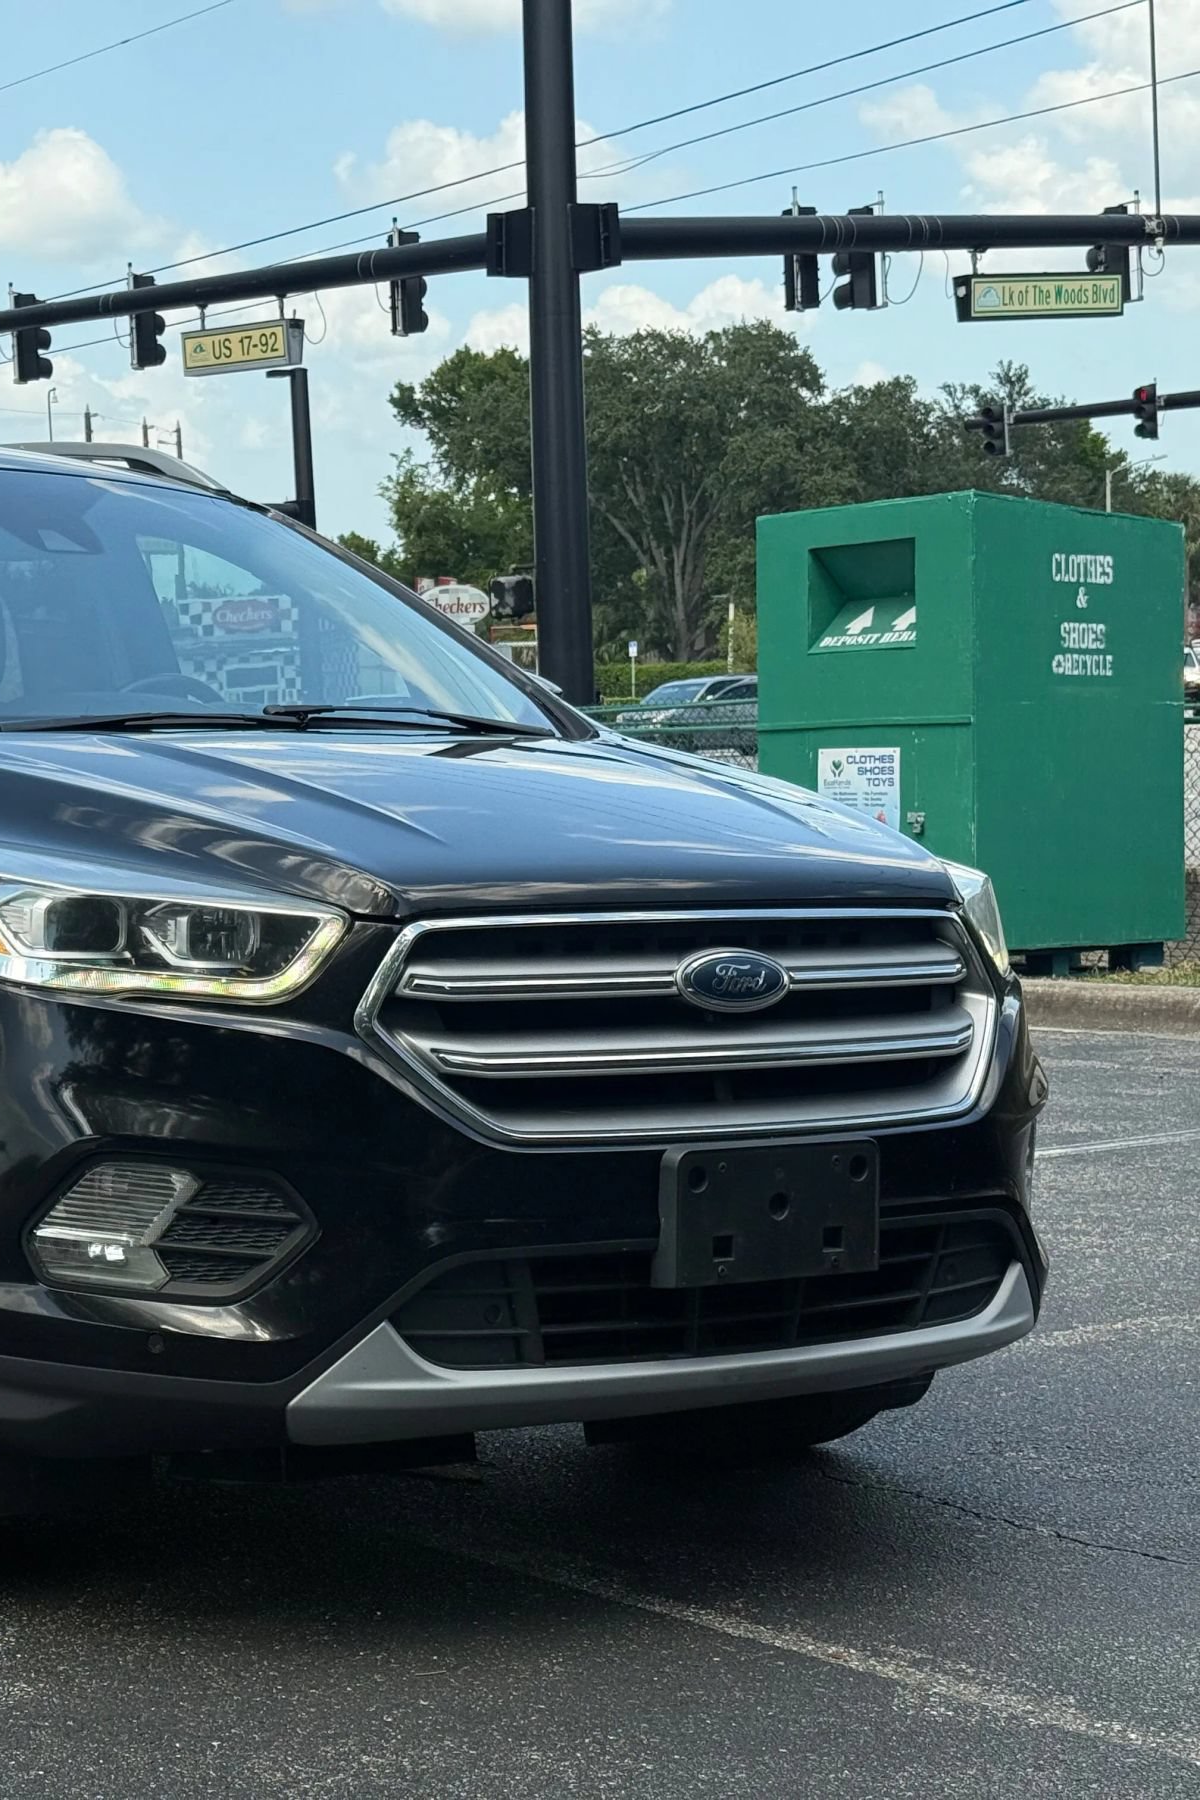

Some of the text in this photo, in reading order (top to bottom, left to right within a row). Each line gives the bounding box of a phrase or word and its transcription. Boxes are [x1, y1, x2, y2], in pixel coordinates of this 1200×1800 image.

[1002, 283, 1115, 307] Lk of The Woods Blvd
[211, 331, 279, 360] US 17-92
[1052, 553, 1113, 584] CLOTHES
[428, 596, 486, 614] heckers
[1076, 586, 1090, 608] &
[818, 632, 881, 648] DEPOSIT
[1060, 622, 1106, 649] SHOES
[1064, 653, 1113, 676] RECYCLE
[846, 754, 895, 765] CLOTHES
[857, 766, 895, 776] SHOES
[865, 777, 895, 787] TOYS
[711, 963, 767, 994] Ford
